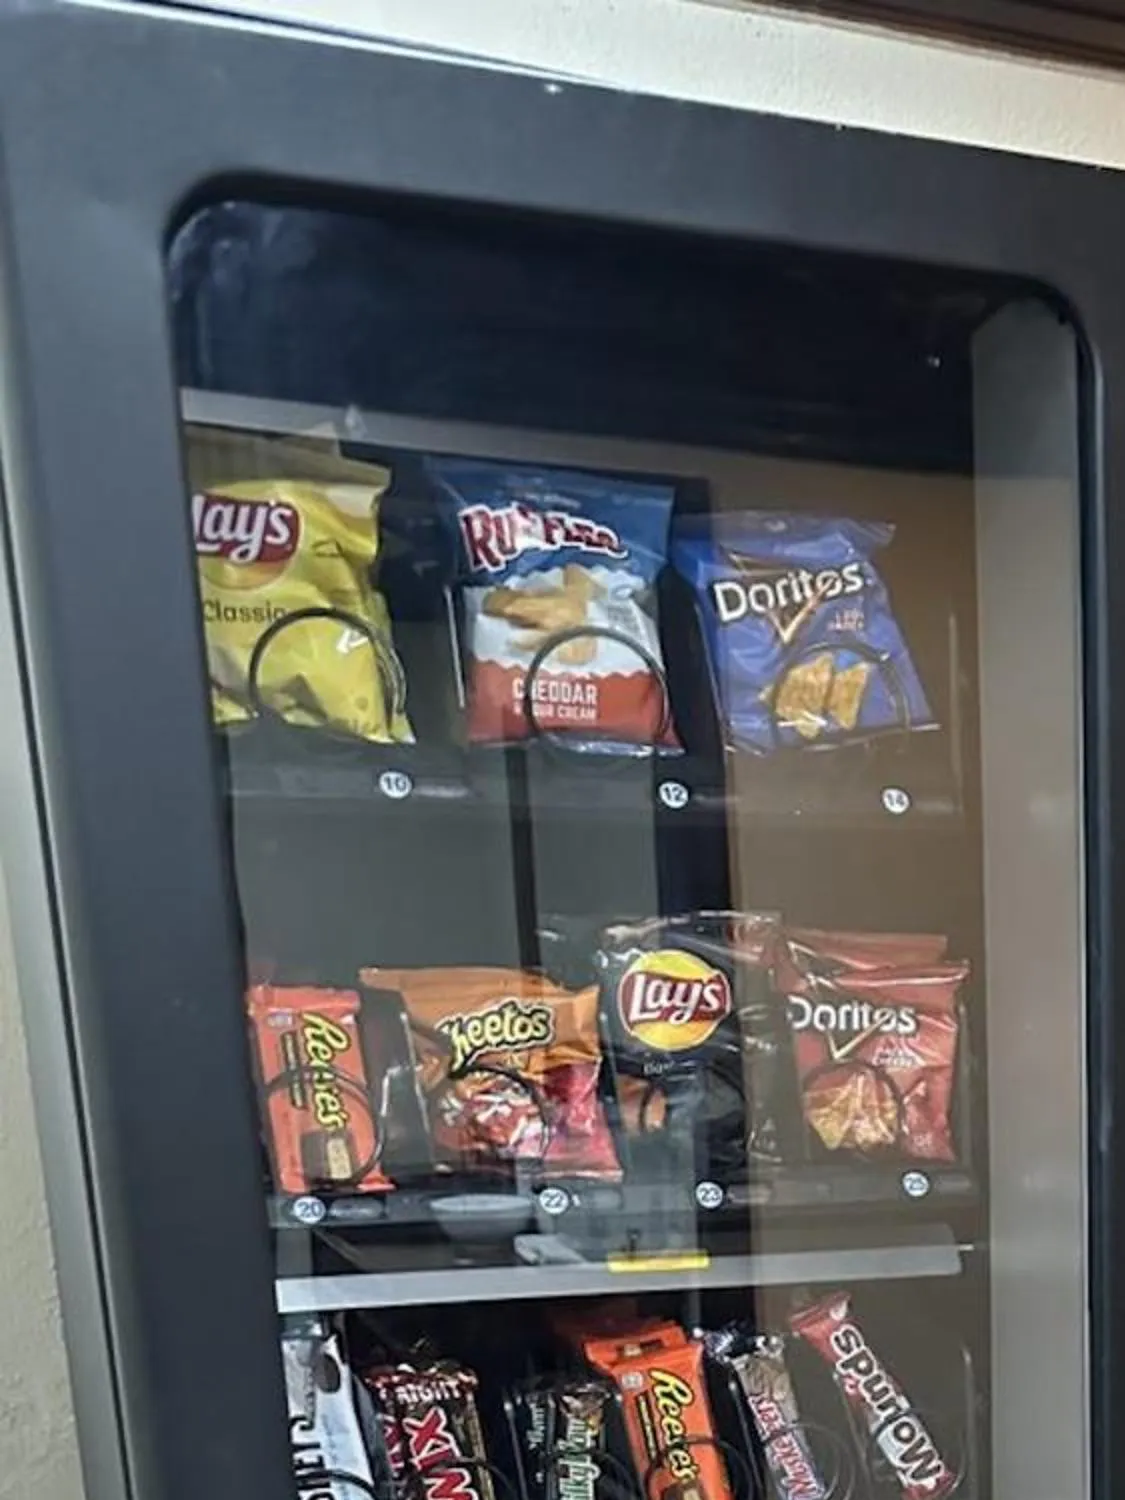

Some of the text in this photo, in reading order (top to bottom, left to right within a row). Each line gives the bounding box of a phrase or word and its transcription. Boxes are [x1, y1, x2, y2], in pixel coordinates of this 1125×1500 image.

[713, 562, 865, 623] Doritos
[786, 994, 917, 1033] Doritos
[830, 1322, 945, 1484] Mounds
